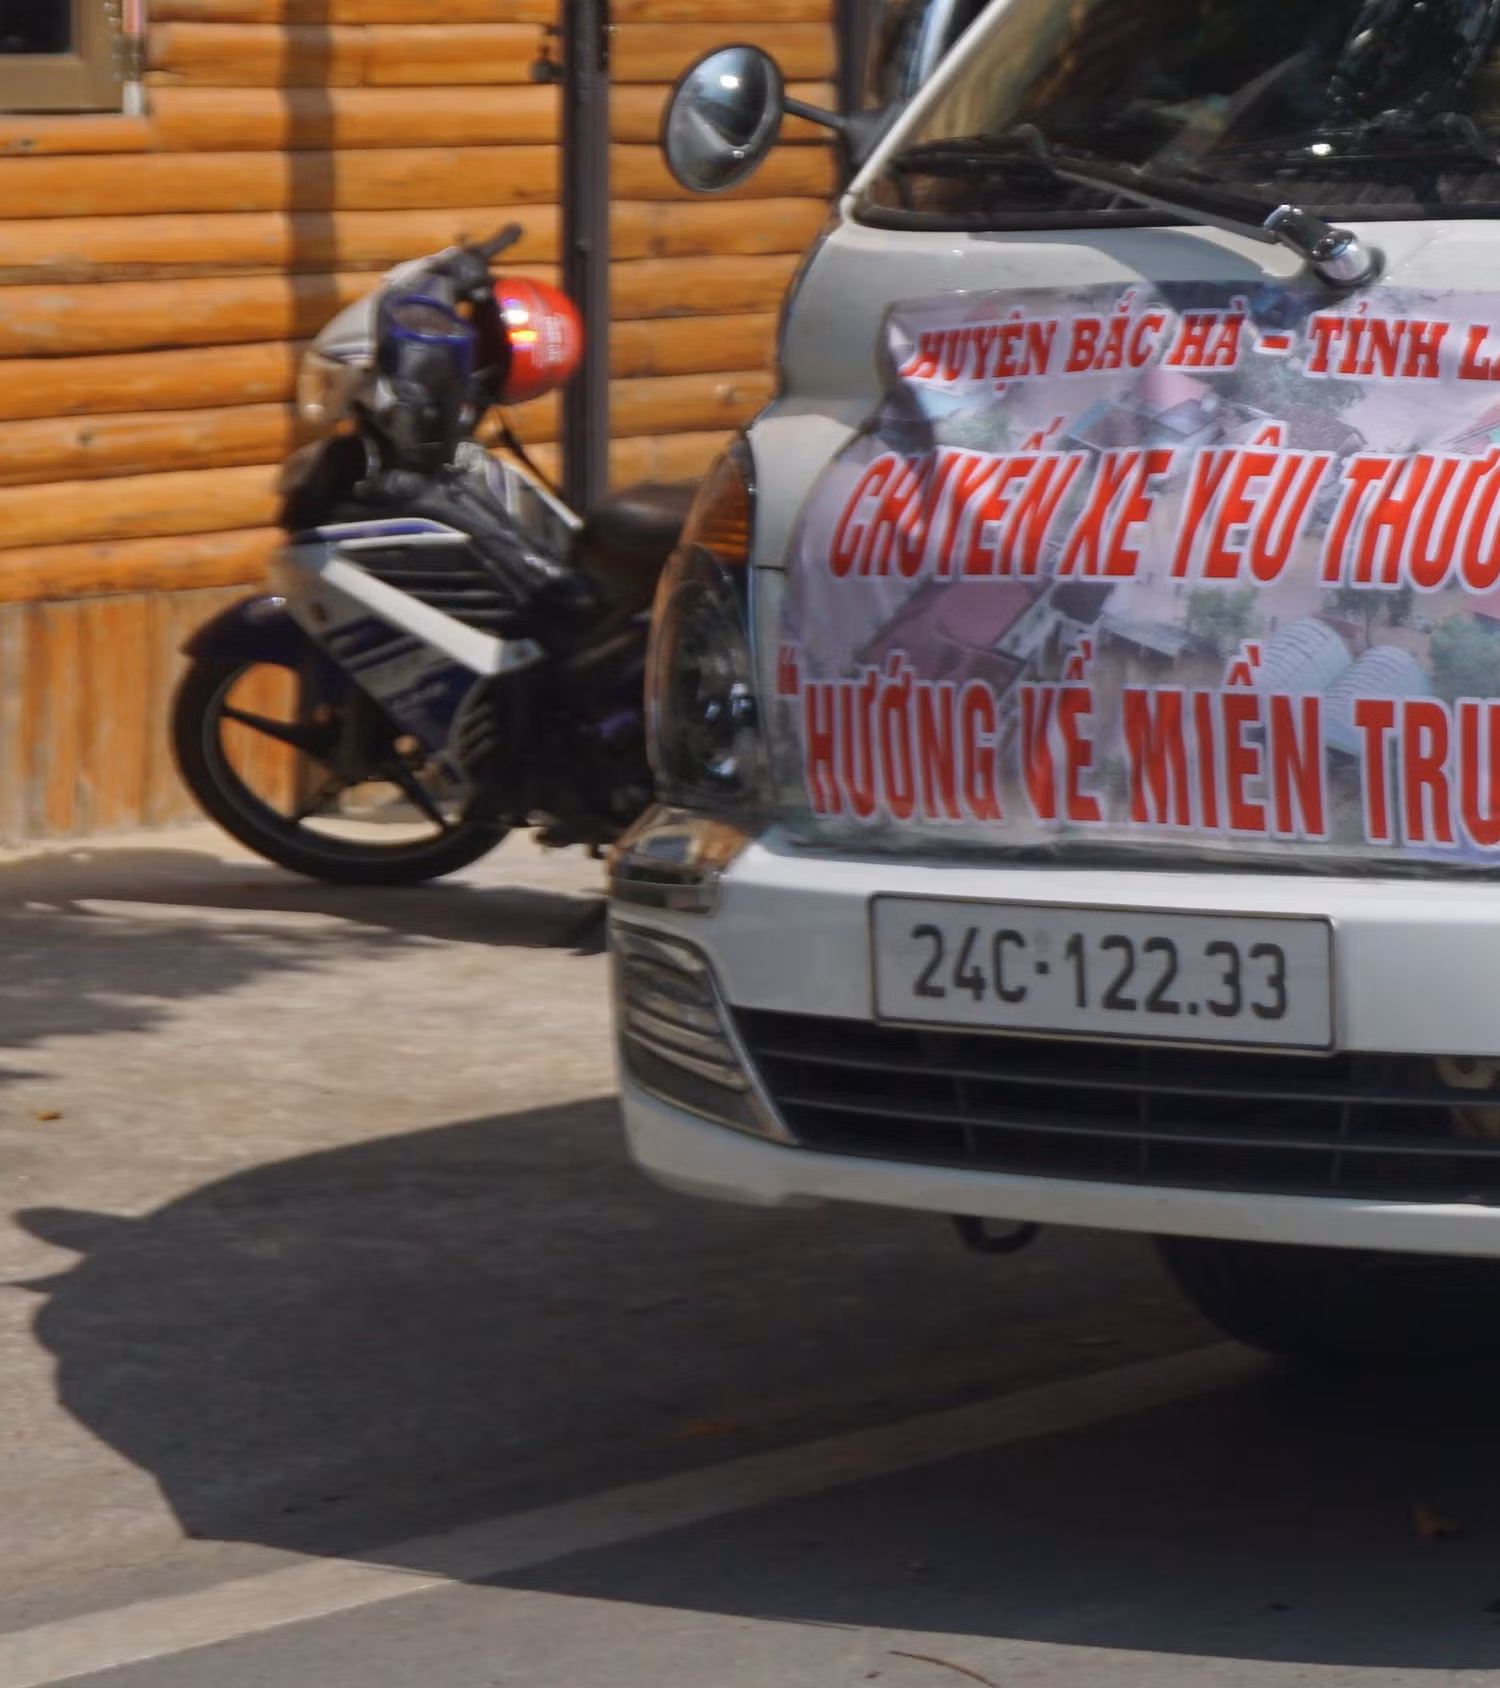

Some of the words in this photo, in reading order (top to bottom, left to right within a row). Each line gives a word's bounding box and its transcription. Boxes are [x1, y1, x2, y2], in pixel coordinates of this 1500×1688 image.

[900, 317, 1058, 392] HUYỆN
[1064, 292, 1167, 375] BẮC
[1168, 298, 1246, 368] HÀ
[1309, 304, 1452, 380] TỈNH
[829, 417, 1083, 580] CHUYẾN
[1061, 451, 1175, 580] XE
[1172, 425, 1330, 583] YÊU
[1020, 640, 1102, 824] VỀ
[1124, 643, 1327, 839] MIỀN
